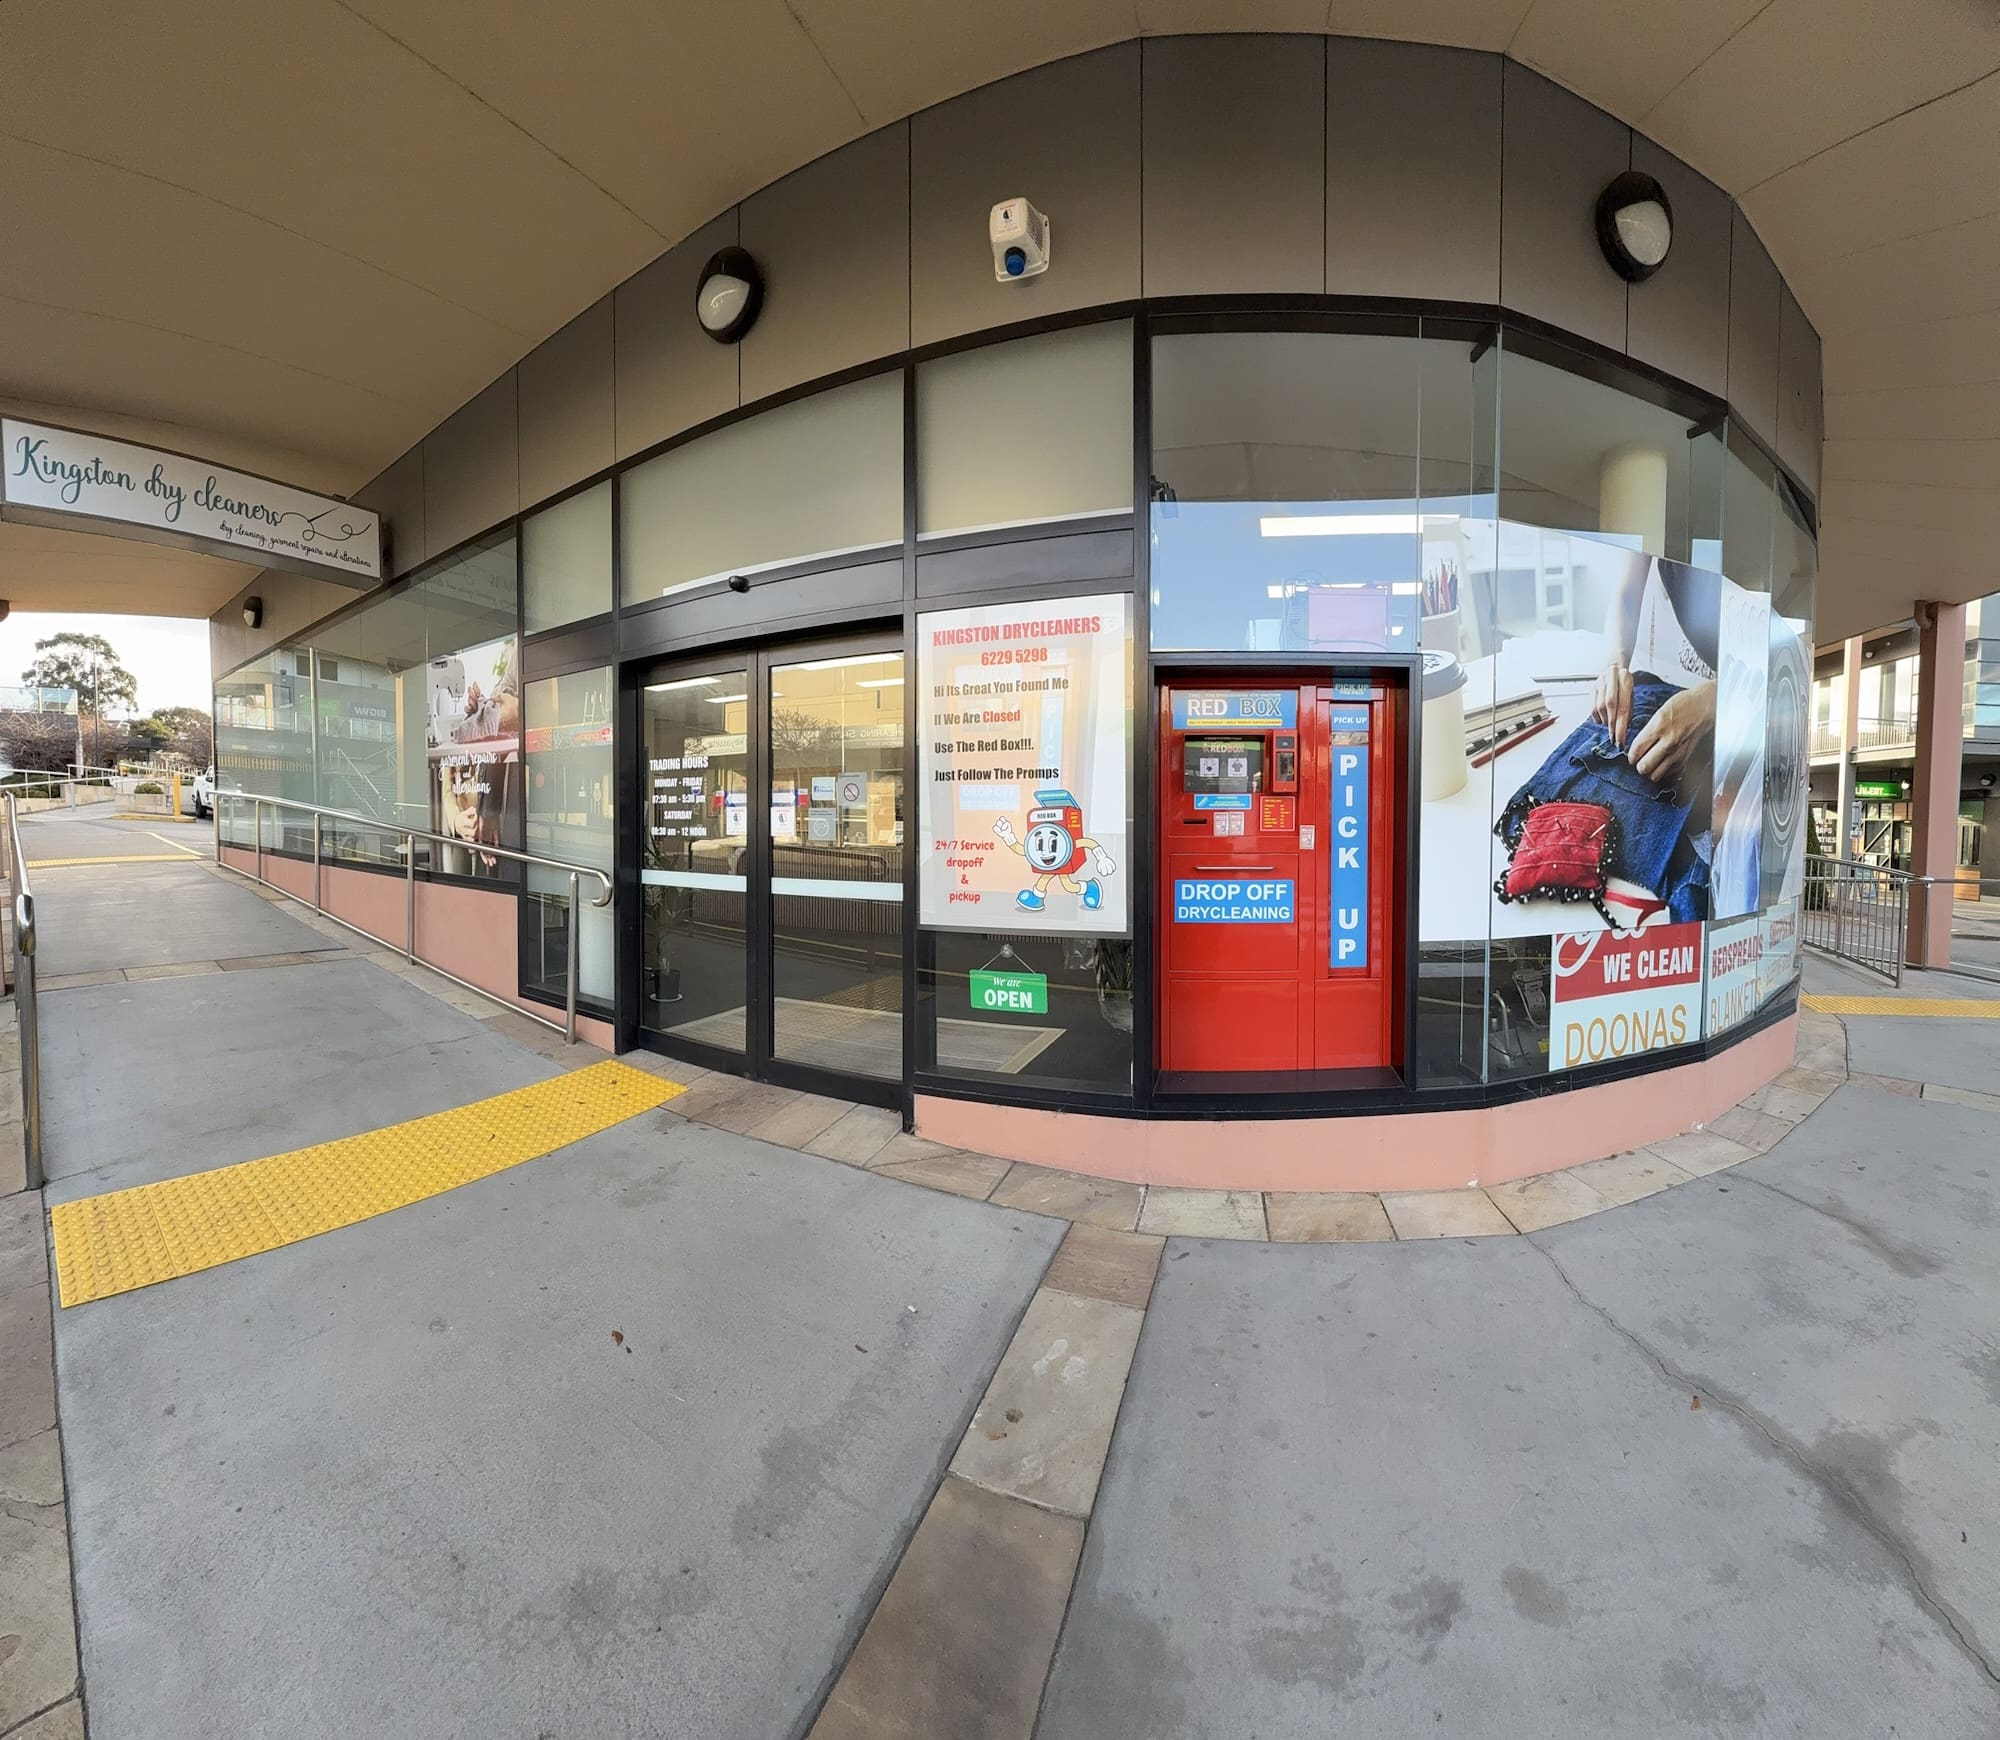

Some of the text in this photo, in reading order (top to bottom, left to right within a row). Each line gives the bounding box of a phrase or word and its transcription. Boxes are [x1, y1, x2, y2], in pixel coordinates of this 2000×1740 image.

[12, 436, 282, 527] Kingston dry cleaners
[219, 519, 233, 539] dry
[267, 537, 300, 550] garment
[325, 549, 339, 559] and
[932, 616, 1101, 646] KINGSTON DRYCLEANERS
[981, 647, 1048, 666] 6229 5298
[933, 677, 1069, 697] Hi Its Great You Found Me
[1187, 697, 1282, 717] RED BOX
[934, 709, 1021, 725] If We Are Closed
[1333, 716, 1367, 724] PICK UP
[934, 741, 953, 754] Use
[956, 740, 975, 753] The
[977, 739, 998, 752] Red
[438, 749, 497, 783] garment repairs
[649, 755, 709, 771] TRADING HOURS
[654, 778, 678, 788] MONDAY
[682, 777, 703, 786] FRIDAY
[934, 767, 1059, 782] Just Follow The Promps
[451, 776, 492, 794] alterations
[663, 810, 693, 820] SATURDAY
[1337, 753, 1361, 869] PICK
[681, 827, 689, 836] 12
[689, 827, 707, 836] NOON
[935, 839, 995, 851] 24/7 Service
[946, 857, 984, 870] dropoff
[960, 874, 969, 885] &
[949, 892, 981, 904] pickup
[1180, 884, 1287, 901] DROP OFF
[1178, 906, 1291, 920] DRYCLEANING
[1337, 908, 1360, 960] UP
[1602, 952, 1632, 984] WE
[1637, 946, 1694, 980] CLEAN
[1711, 934, 1764, 979] BEDSPREADS
[993, 976, 1021, 987] We are
[983, 988, 1033, 1009] OPEN
[1564, 1003, 1688, 1068] DOONAS
